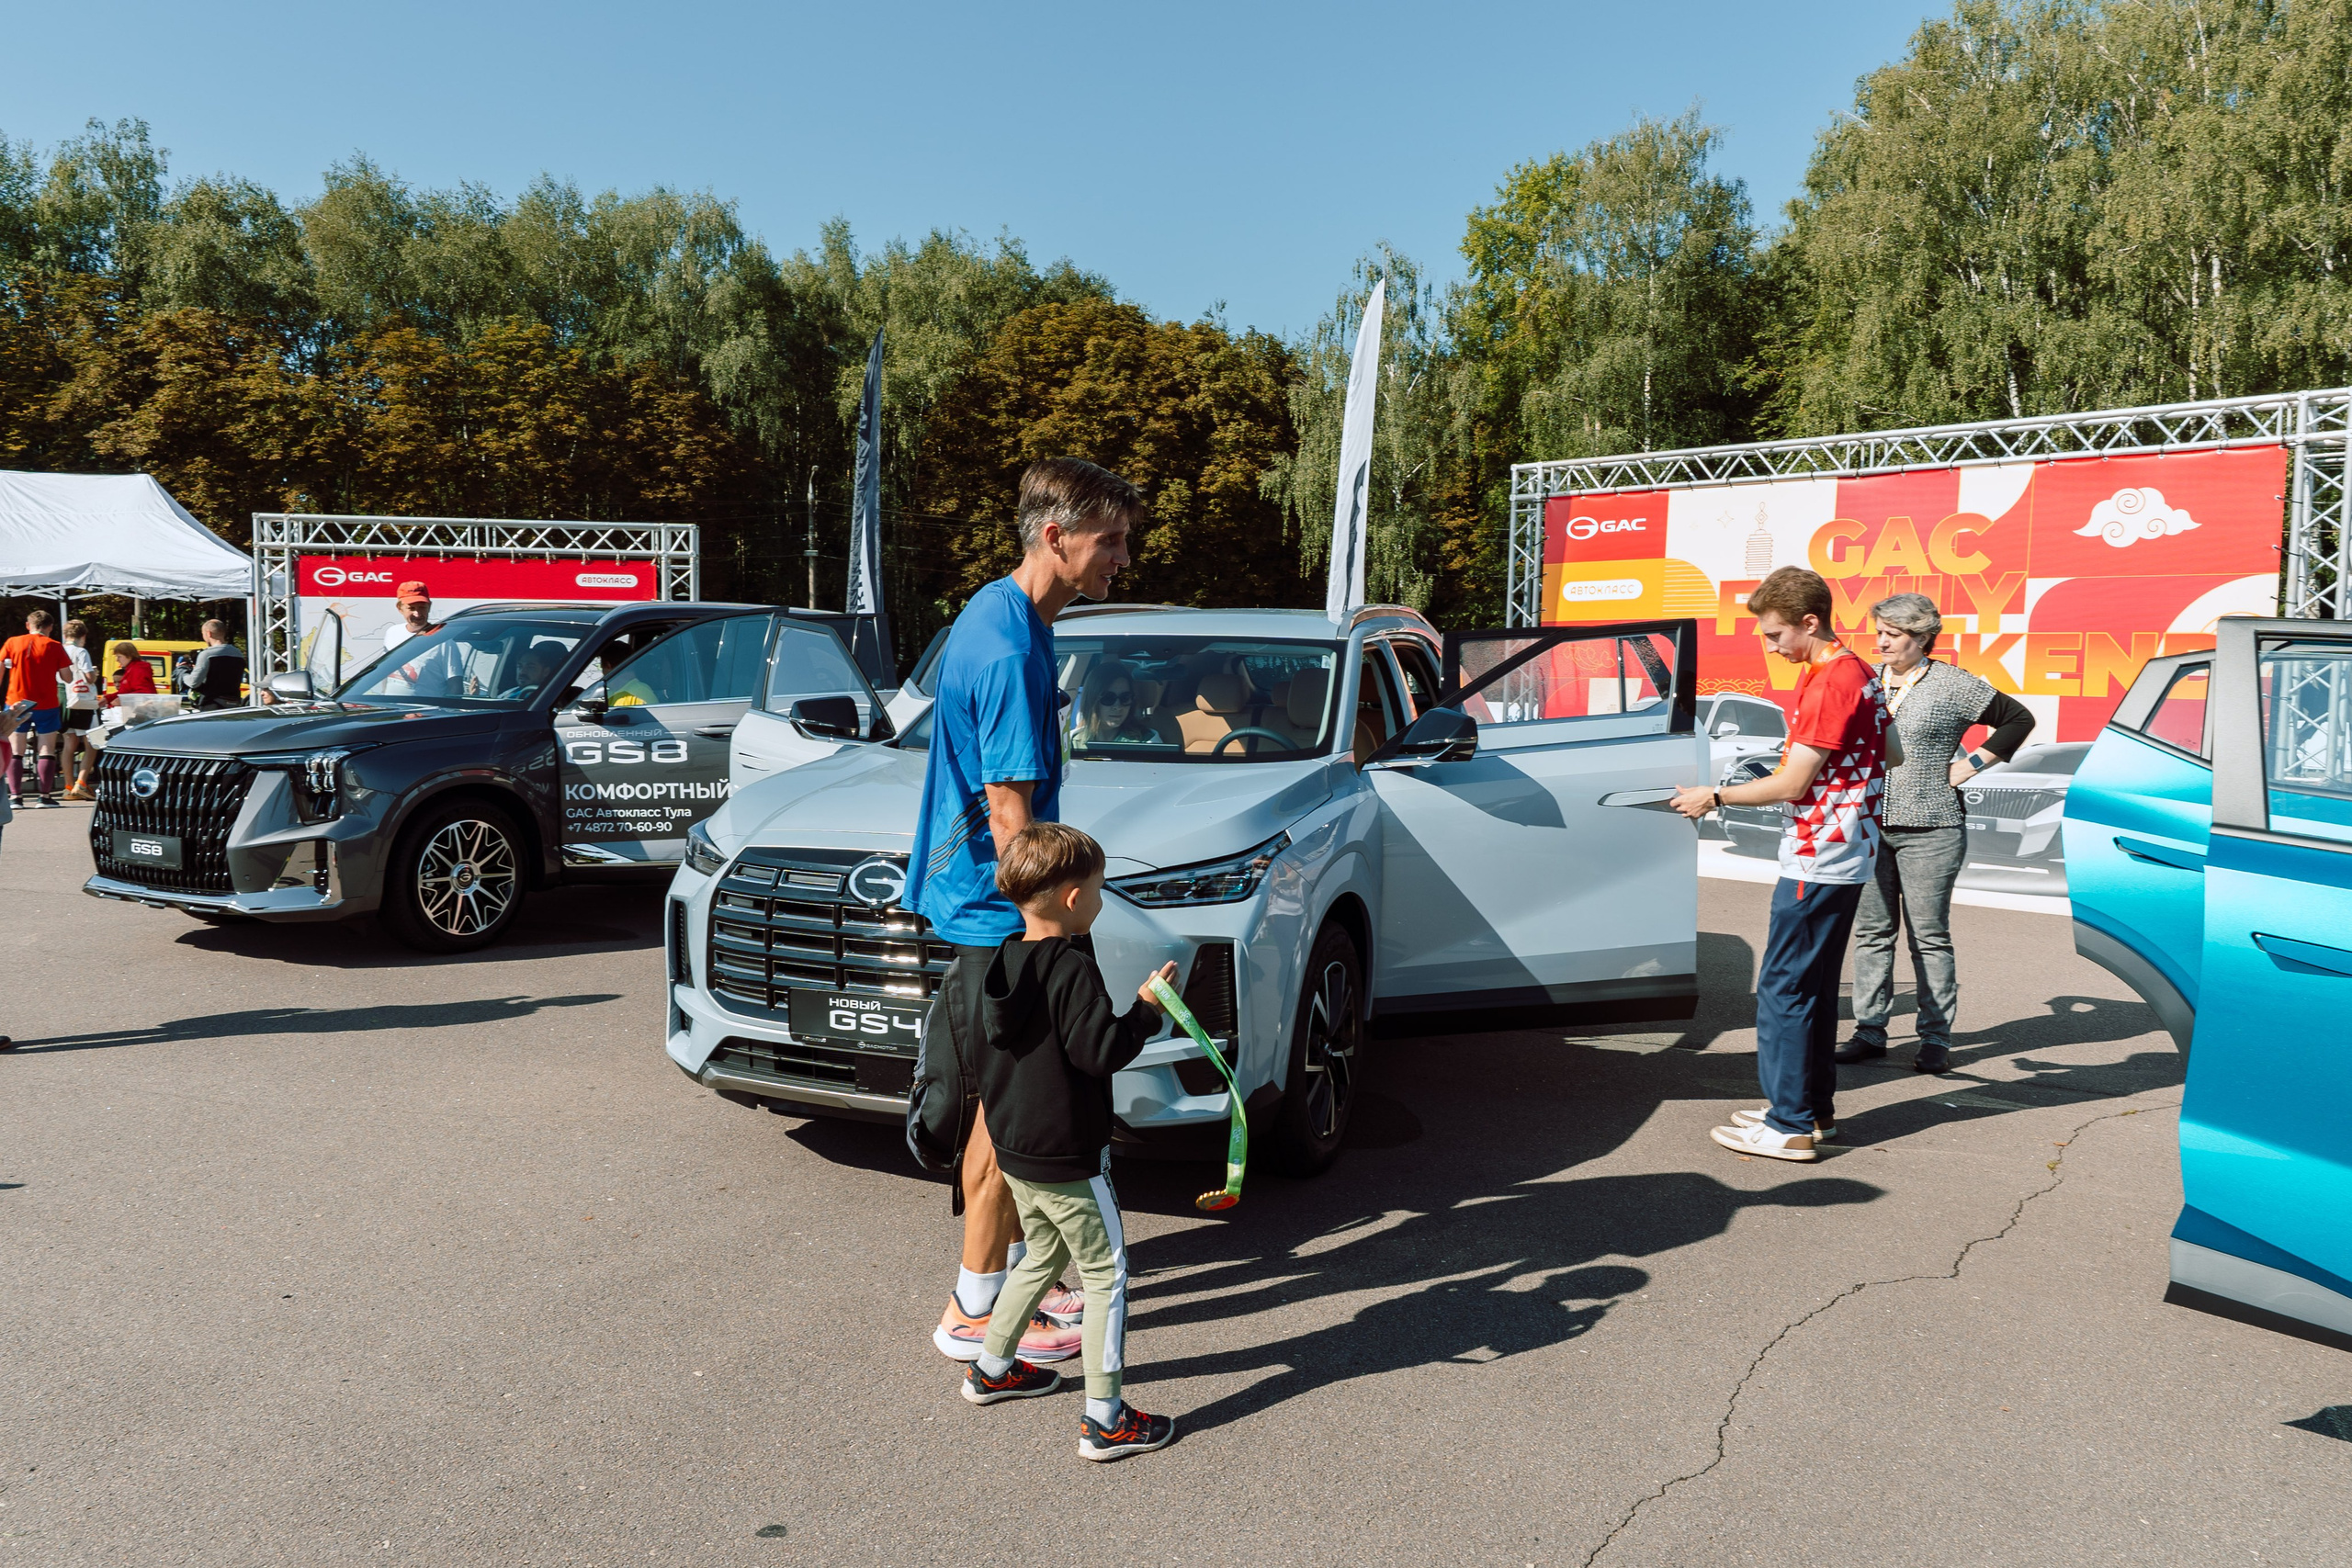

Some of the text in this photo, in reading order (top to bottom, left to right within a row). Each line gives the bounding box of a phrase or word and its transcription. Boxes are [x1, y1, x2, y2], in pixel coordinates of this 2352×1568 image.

[1600, 517, 1647, 533] GAC
[1807, 512, 1996, 580] GAC
[347, 571, 393, 582] GAC
[582, 576, 632, 584] АВТОКЛАСС
[1569, 584, 1635, 595] АВТОКЛАСС
[566, 728, 662, 739] ОБНОВЛЕННЫЙ
[565, 739, 688, 765] GS8
[564, 778, 733, 800] КОМФОРТНЫЙ
[566, 807, 692, 819] GAC Автокласс Тула
[567, 821, 673, 832] +7 4872 70-60-90
[130, 842, 163, 856] GS8
[829, 997, 881, 1011] НОВЫЙ
[829, 1010, 922, 1039] GS4
